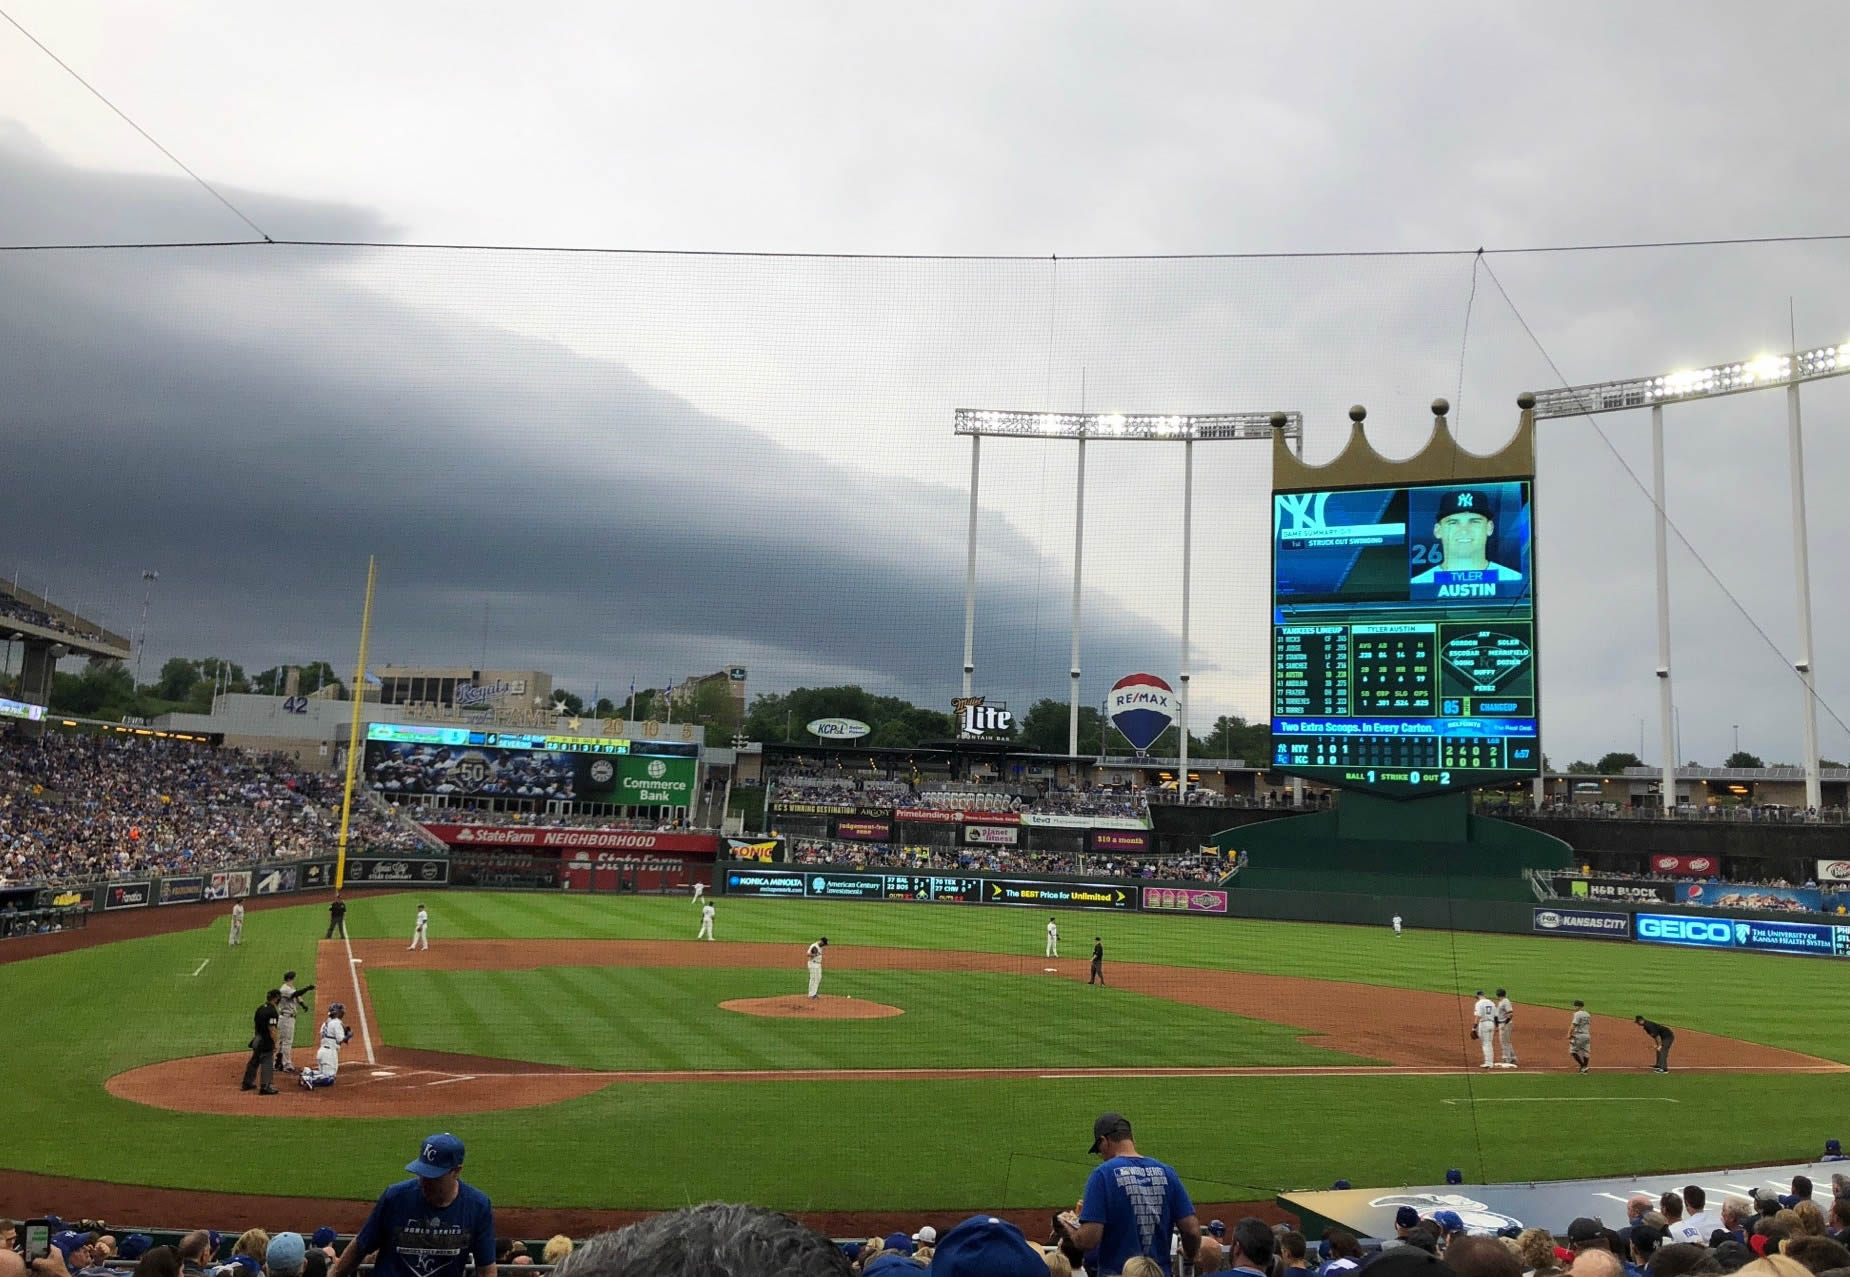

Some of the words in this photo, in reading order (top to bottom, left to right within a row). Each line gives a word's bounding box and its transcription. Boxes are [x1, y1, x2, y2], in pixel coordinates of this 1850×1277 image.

[1412, 544, 1442, 564] 26
[1450, 571, 1484, 581] TYLER
[1438, 583, 1496, 597] AUSTIN
[456, 679, 510, 704] Royals
[283, 696, 308, 713] 42
[1116, 692, 1168, 707] RE/MAX
[1444, 700, 1459, 714] 85
[1480, 703, 1518, 711] CHANGEUP
[403, 699, 467, 723] HALL
[495, 707, 560, 729] FAME
[963, 705, 1011, 735] Lite
[602, 718, 624, 735] 20
[642, 720, 659, 737] 10
[682, 723, 692, 739] 5
[818, 724, 845, 735] KCP&L
[1281, 722, 1299, 732] Two
[1300, 722, 1324, 732] Extra
[1325, 722, 1361, 733] Scoops.
[1363, 723, 1372, 732] In
[1374, 723, 1400, 734] Every
[1401, 723, 1435, 733] Carton.
[488, 735, 495, 744] 6
[1291, 744, 1309, 752] NYY
[1317, 744, 1323, 753] 1
[1329, 744, 1337, 753] 0
[1342, 744, 1348, 753] 1
[1446, 746, 1453, 755] 2
[1459, 746, 1467, 755] 4
[1472, 746, 1480, 755] 0
[1490, 747, 1497, 756] 2
[1294, 756, 1309, 764] KC
[1317, 756, 1324, 765] 0
[1329, 756, 1337, 765] 0
[1446, 757, 1453, 767] 0
[1459, 757, 1467, 767] 0
[1472, 757, 1480, 767] 0
[1490, 758, 1496, 767] 1
[462, 764, 484, 781] 50
[1367, 770, 1375, 783] 1
[1410, 771, 1420, 784] 0
[1440, 772, 1450, 784] 2
[623, 777, 686, 791] Commerce
[640, 789, 670, 801] Bank
[790, 804, 815, 813] WINNING
[860, 808, 891, 818] ARGOSY
[896, 809, 950, 820] PrimeLending
[1032, 815, 1050, 824] teva
[982, 827, 1008, 837] planet
[544, 833, 656, 847] NEIGHBORHOOD
[1097, 836, 1111, 844] $10
[732, 846, 773, 858] SONIC
[740, 877, 769, 886] KONICA
[770, 878, 803, 887] MINOLTA
[856, 882, 880, 891] Century
[1021, 890, 1039, 898] BEST
[1071, 892, 1111, 902] Unlimited
[1590, 885, 1614, 895] H&R
[1618, 886, 1656, 898] BLOCK
[1562, 916, 1603, 927] KANSAS
[1604, 918, 1626, 929] CITY
[1639, 919, 1731, 942] GEICO
[1768, 930, 1807, 938] UNIVERSITY
[1779, 938, 1805, 946] HEALTH
[1807, 939, 1830, 948] SYSTEM
[423, 1144, 437, 1162] KC
[416, 1254, 435, 1272] KC
